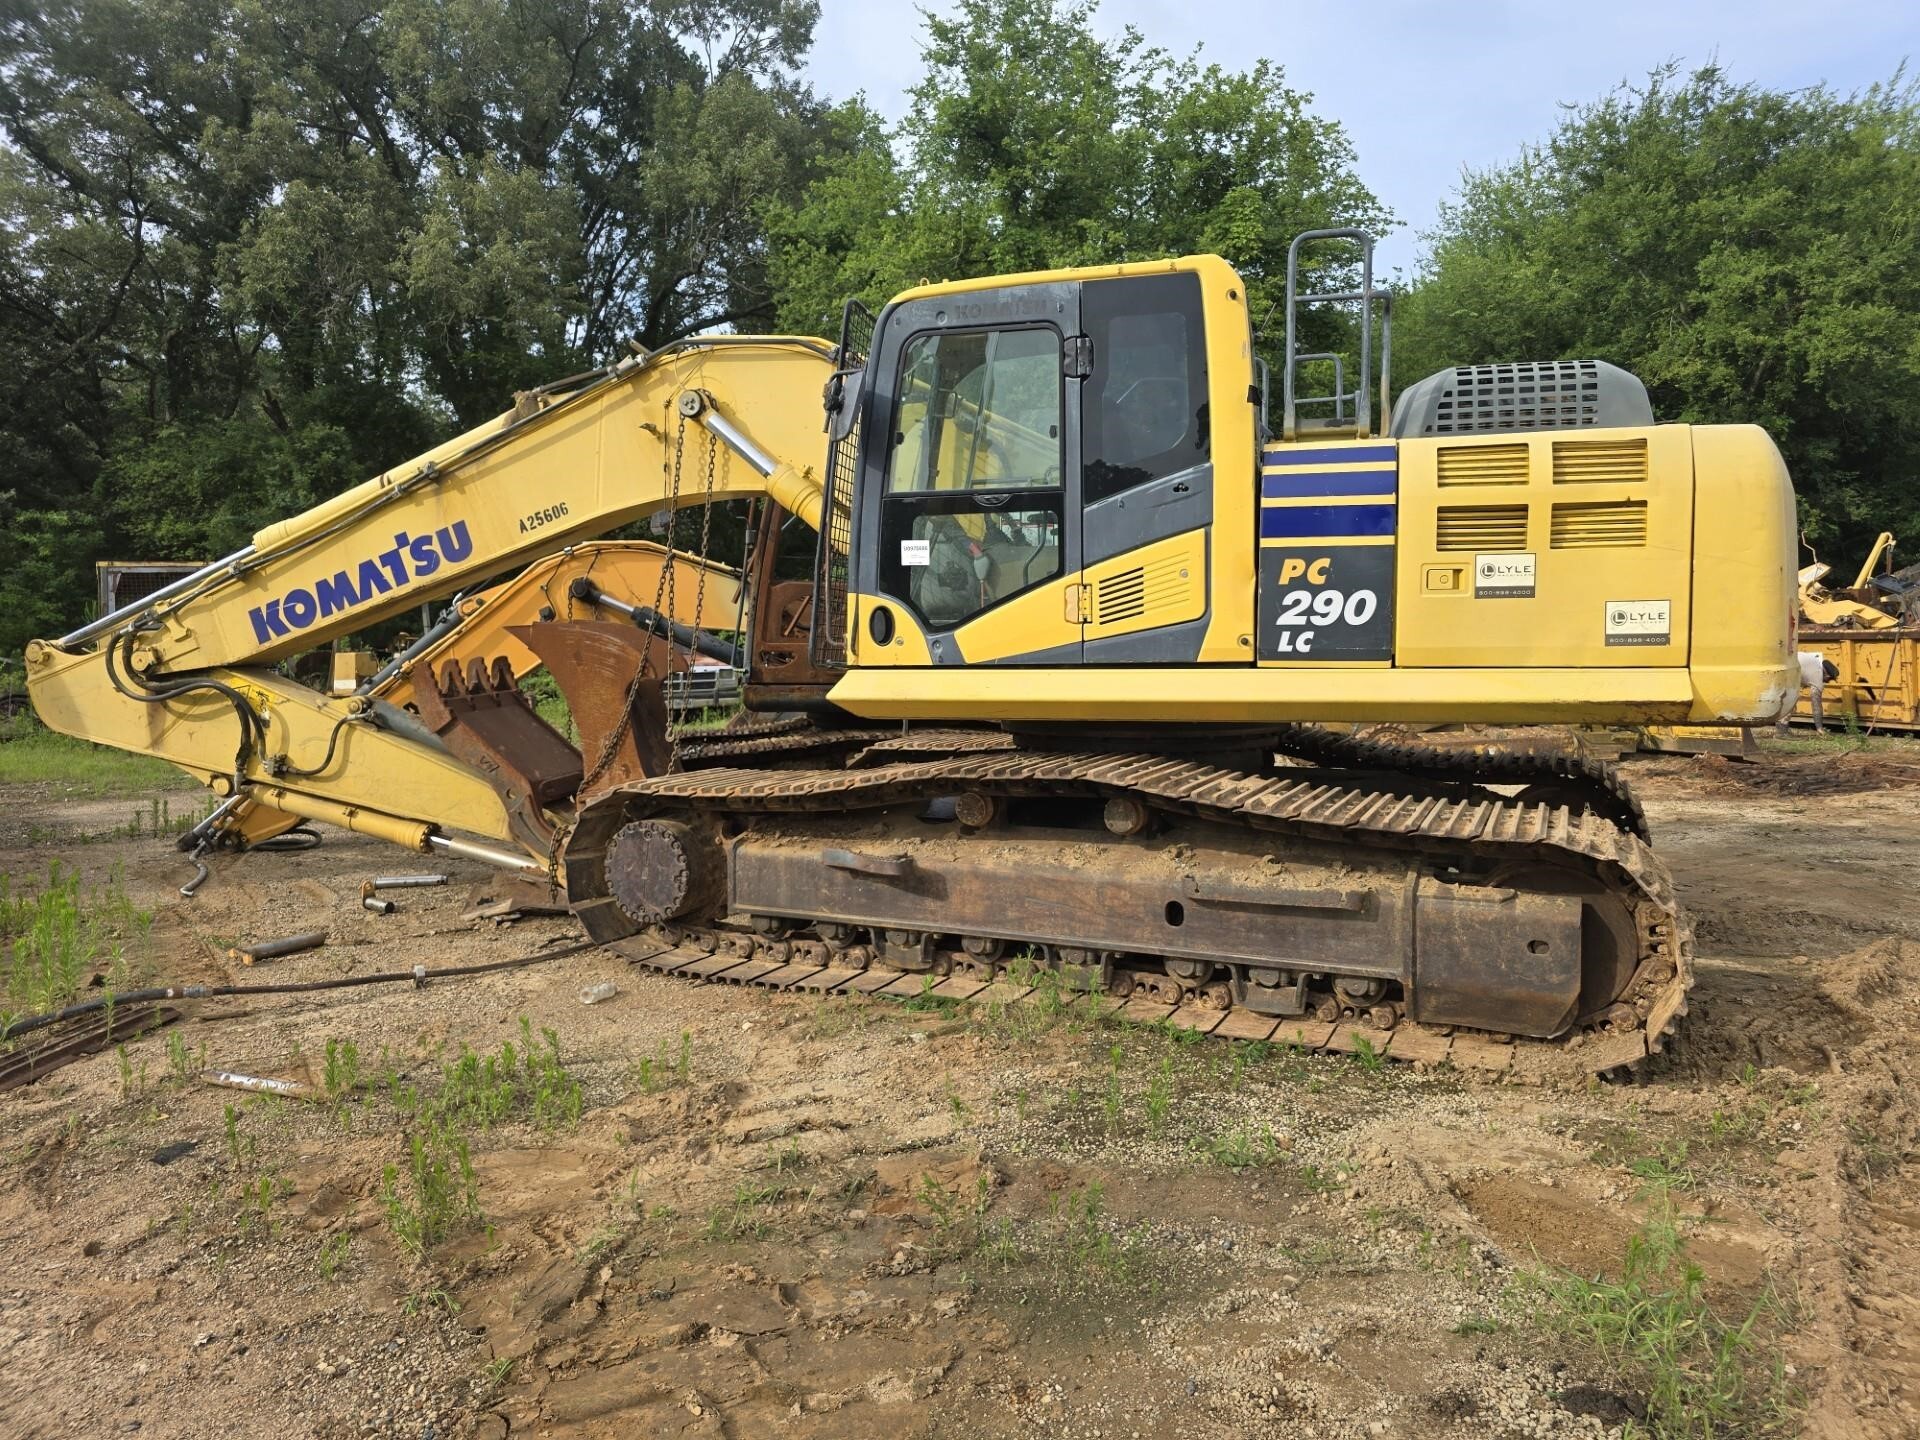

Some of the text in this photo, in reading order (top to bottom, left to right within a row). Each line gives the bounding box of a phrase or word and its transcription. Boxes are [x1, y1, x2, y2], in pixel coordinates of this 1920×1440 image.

[519, 502, 569, 534] A25606
[248, 519, 473, 645] KOMATSU
[1278, 557, 1331, 585] PC
[1497, 565, 1532, 573] LYLE
[1275, 589, 1377, 626] 290
[1629, 612, 1666, 620] LYLE
[1277, 631, 1314, 653] LC
